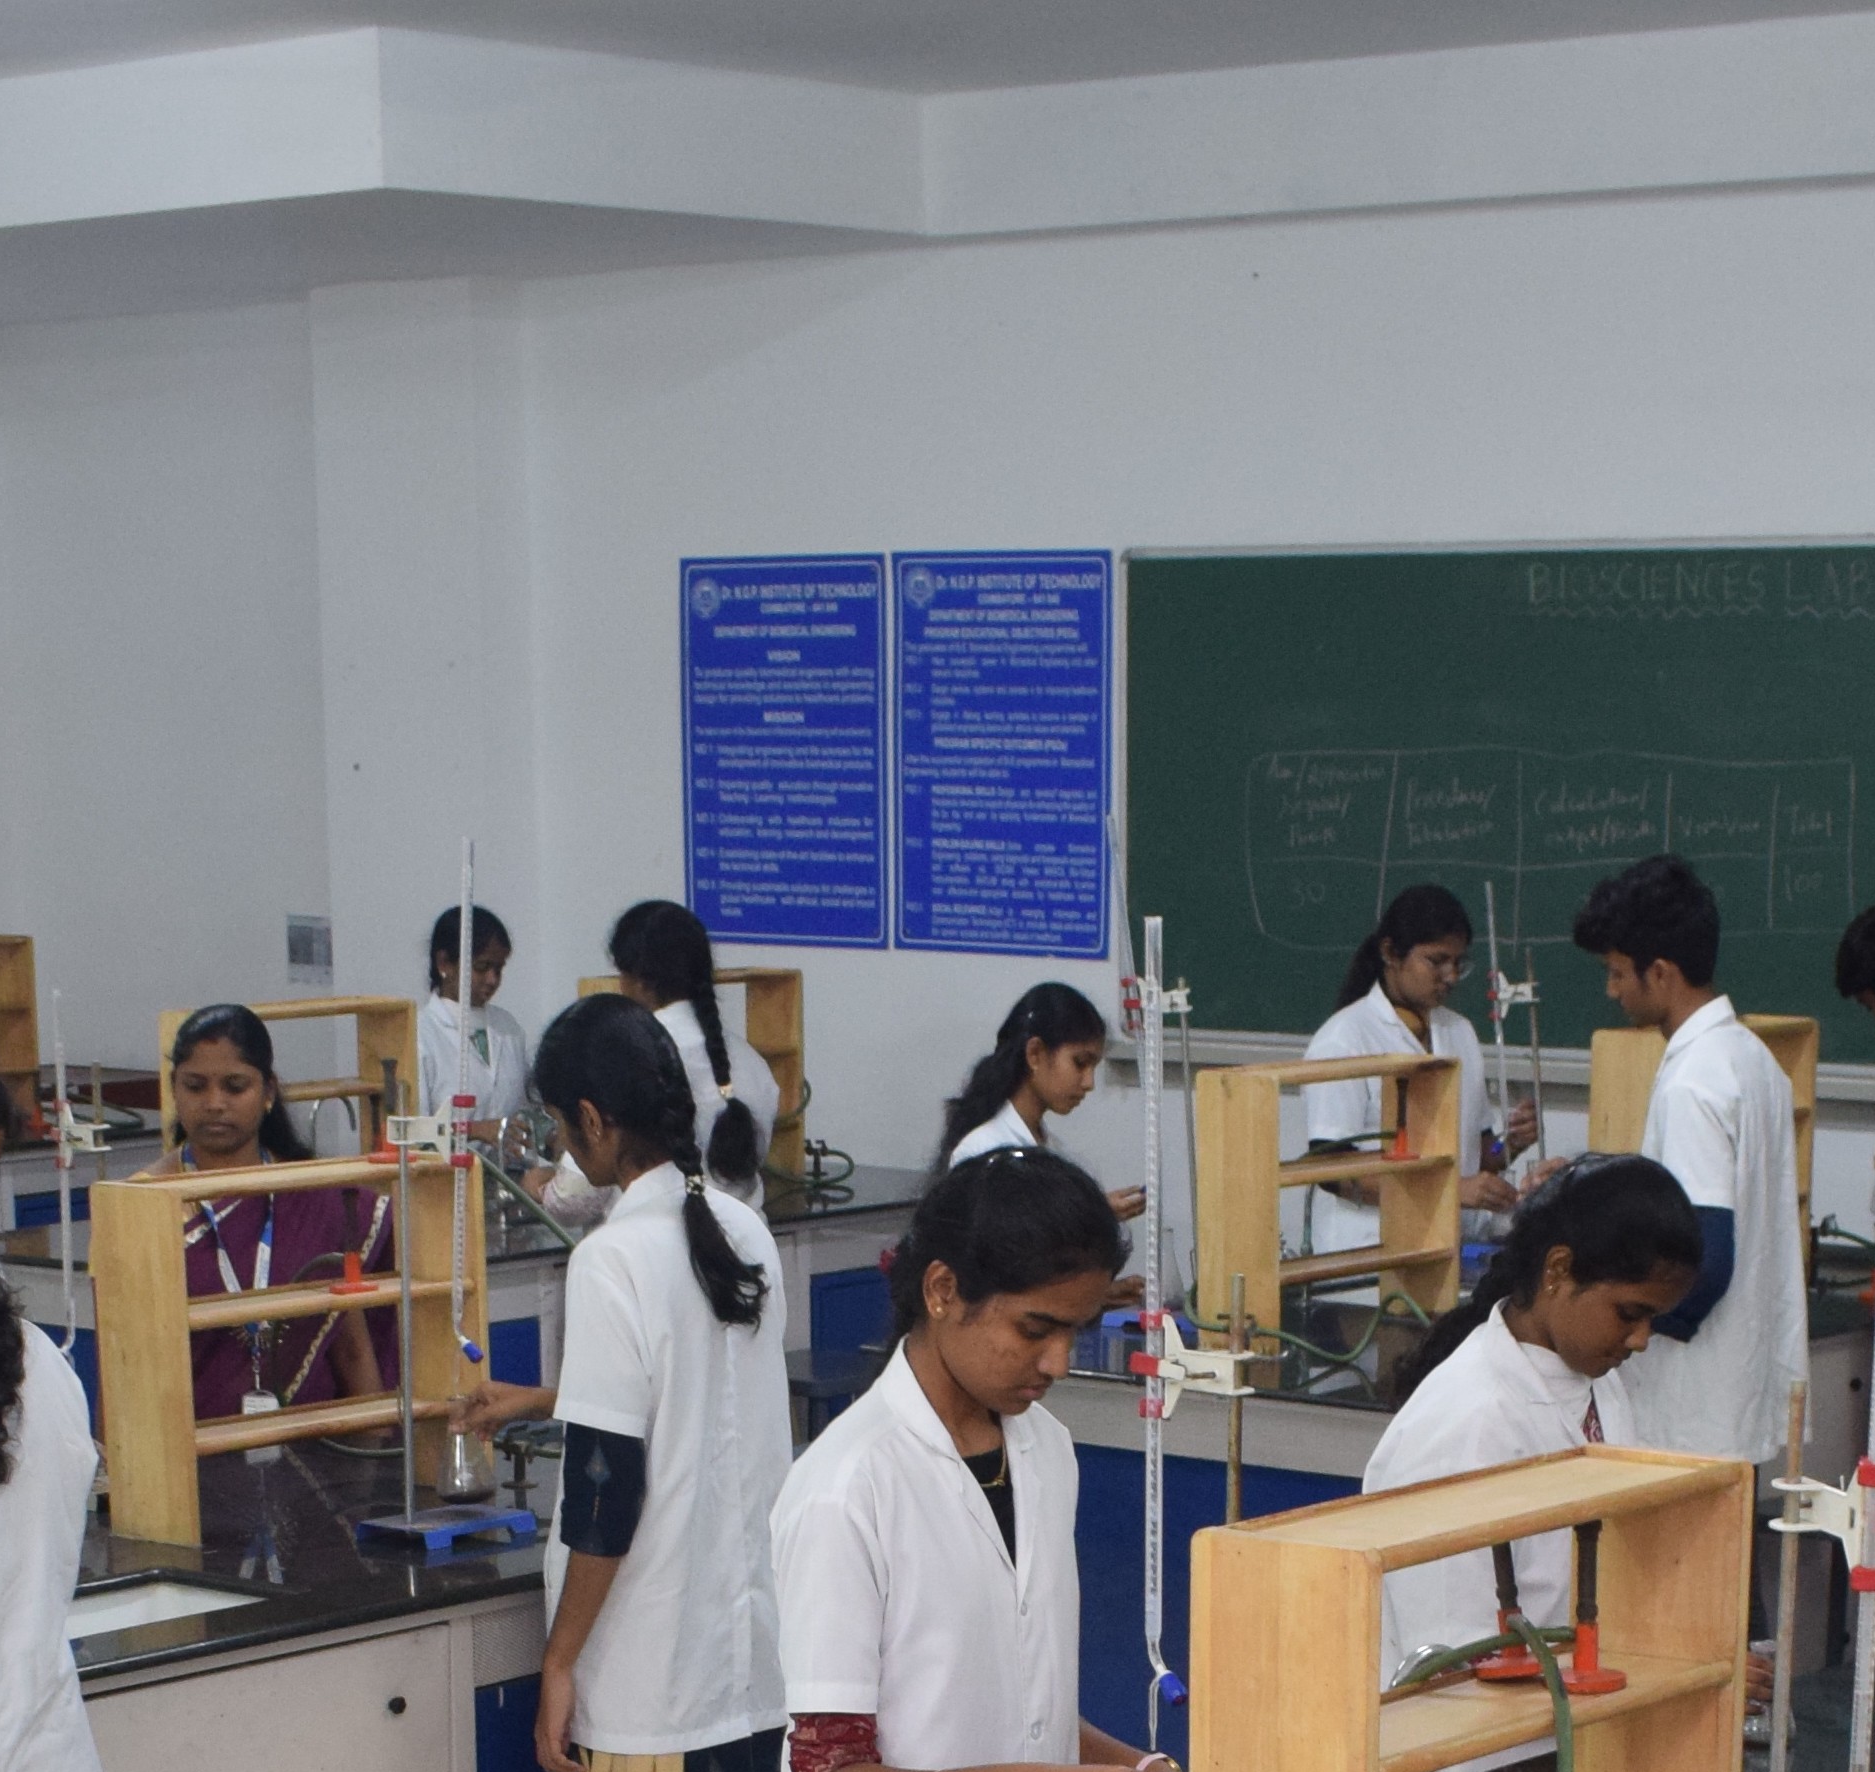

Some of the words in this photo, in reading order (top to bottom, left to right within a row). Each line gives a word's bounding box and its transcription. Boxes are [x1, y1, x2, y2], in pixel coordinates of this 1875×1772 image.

[976, 574, 1022, 589] INSTITUTE
[1024, 574, 1037, 588] OF
[1039, 573, 1101, 589] TECHNOLOGY
[1527, 558, 1765, 604] BIOSCIENCES
[760, 584, 803, 599] INSTITUTE
[804, 583, 817, 597] OF
[818, 582, 877, 598] TECHNOLOGY
[767, 649, 801, 662] VISION
[763, 711, 805, 724] MISSION
